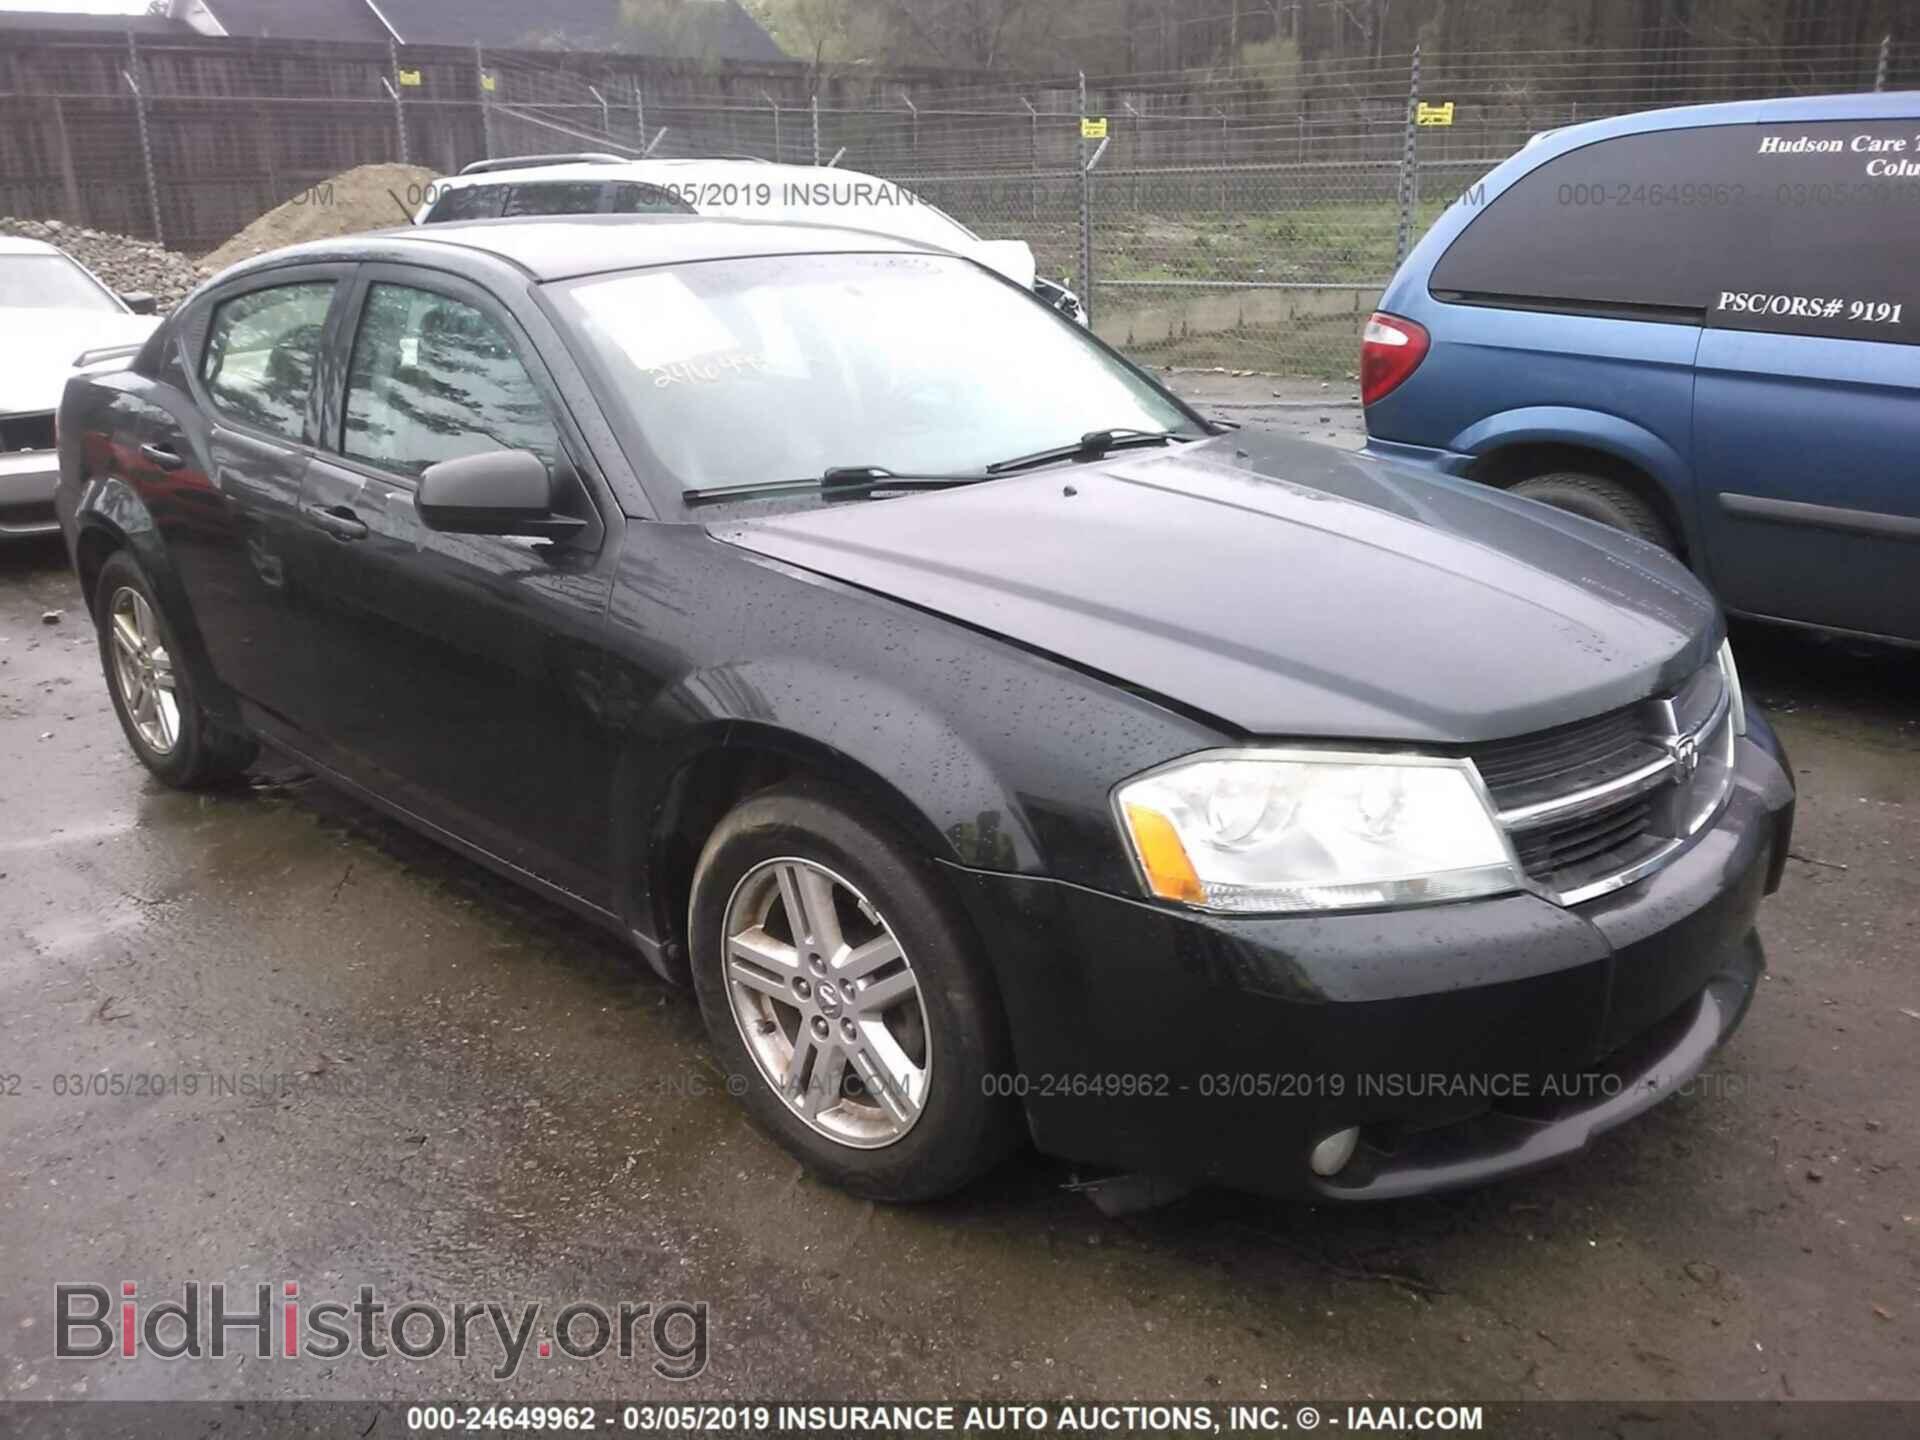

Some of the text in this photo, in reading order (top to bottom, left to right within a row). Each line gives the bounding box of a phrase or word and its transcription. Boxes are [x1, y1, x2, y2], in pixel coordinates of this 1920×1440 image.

[1758, 136, 1844, 153] Hudson
[1850, 135, 1907, 152] Care
[1866, 158, 1920, 177] Colu
[1717, 291, 1903, 323] PSC/ORS# 9191
